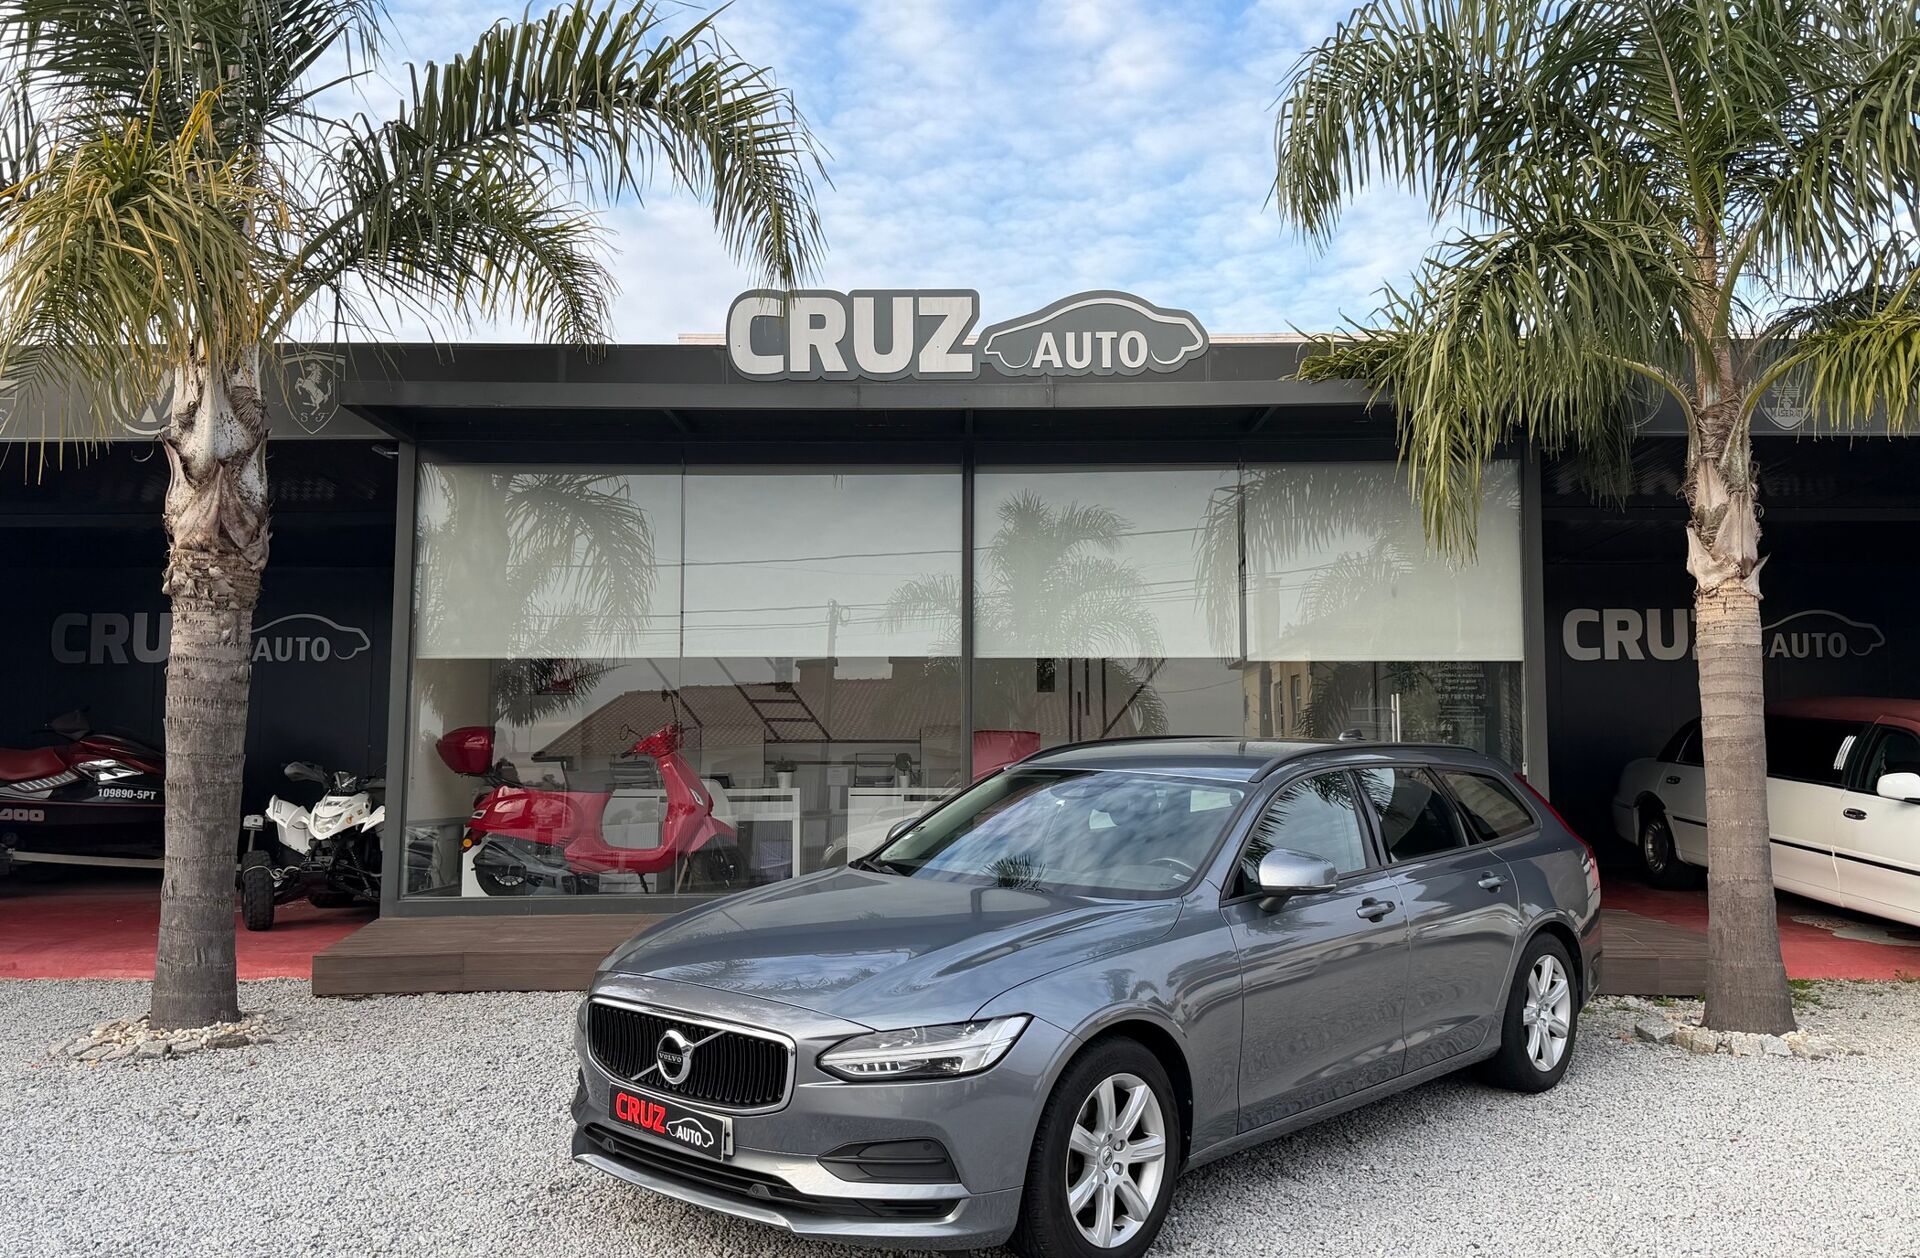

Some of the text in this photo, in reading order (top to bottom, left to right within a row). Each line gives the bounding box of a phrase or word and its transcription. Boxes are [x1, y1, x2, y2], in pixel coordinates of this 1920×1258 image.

[729, 296, 1149, 375] CRUZ AUTO
[51, 612, 331, 665] CRU AUTO
[1562, 608, 1848, 661] CRU AUTO
[97, 787, 157, 801] 109890-5PT
[658, 1052, 682, 1063] VOLVO
[615, 1092, 702, 1146] CRUZ AUTO
